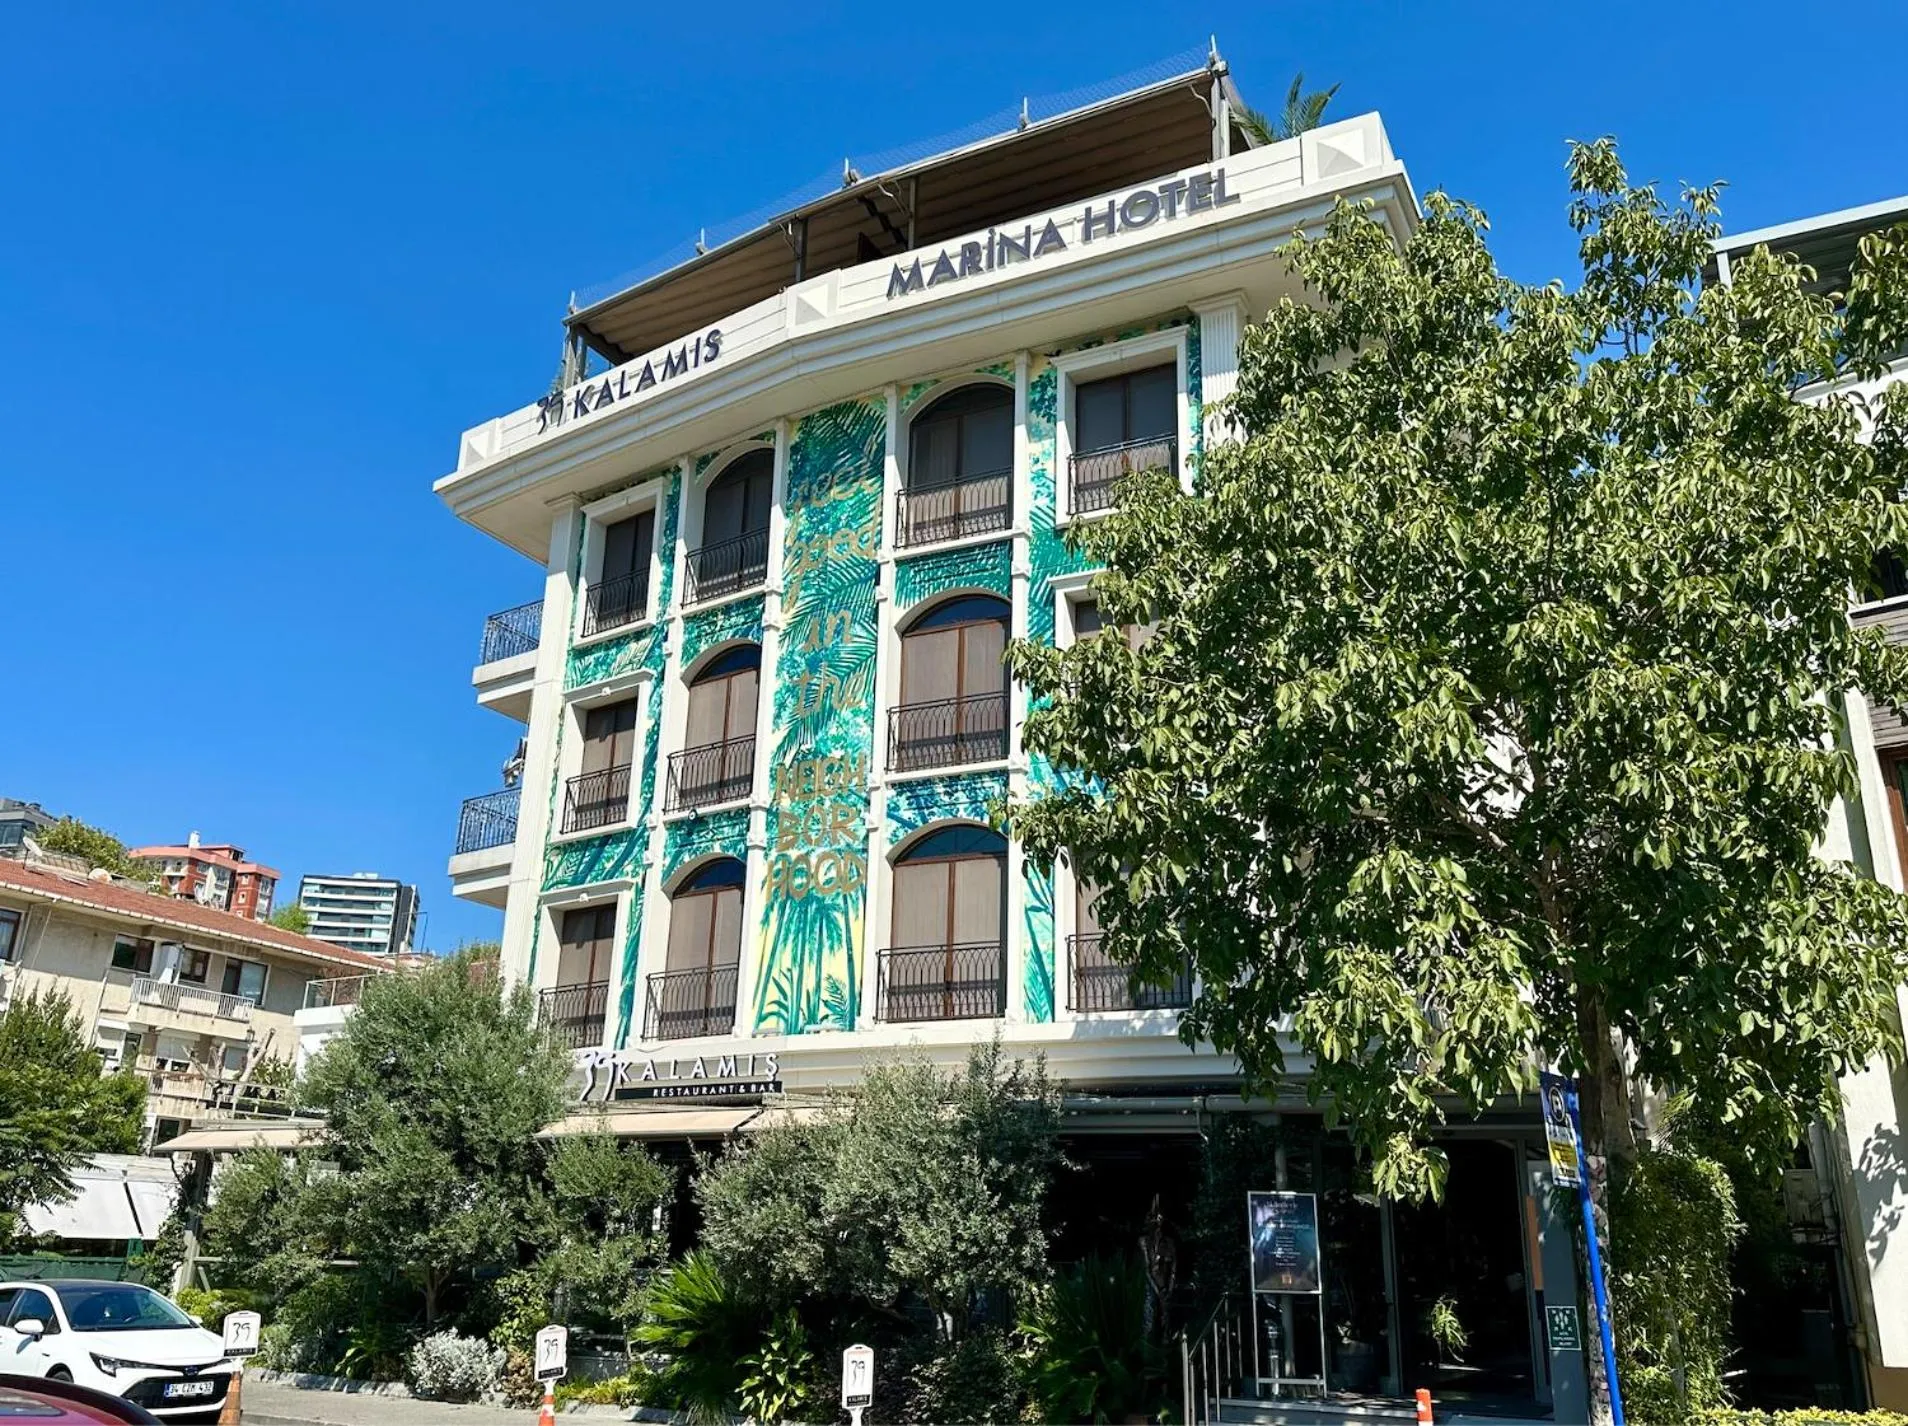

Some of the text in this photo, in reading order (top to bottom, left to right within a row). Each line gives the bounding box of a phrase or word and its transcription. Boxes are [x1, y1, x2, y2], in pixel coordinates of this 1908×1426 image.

[1081, 167, 1241, 244] HOTEL
[781, 493, 882, 613] good
[803, 608, 852, 652] in
[790, 660, 865, 718] the
[775, 752, 867, 804] NEIGH
[775, 803, 860, 853] BOR
[765, 851, 867, 902] HOOD
[617, 1053, 779, 1085] KALAMIŞ
[653, 1084, 735, 1097] RESTAURANT
[750, 1083, 775, 1093] BAR
[233, 1322, 250, 1344] 39
